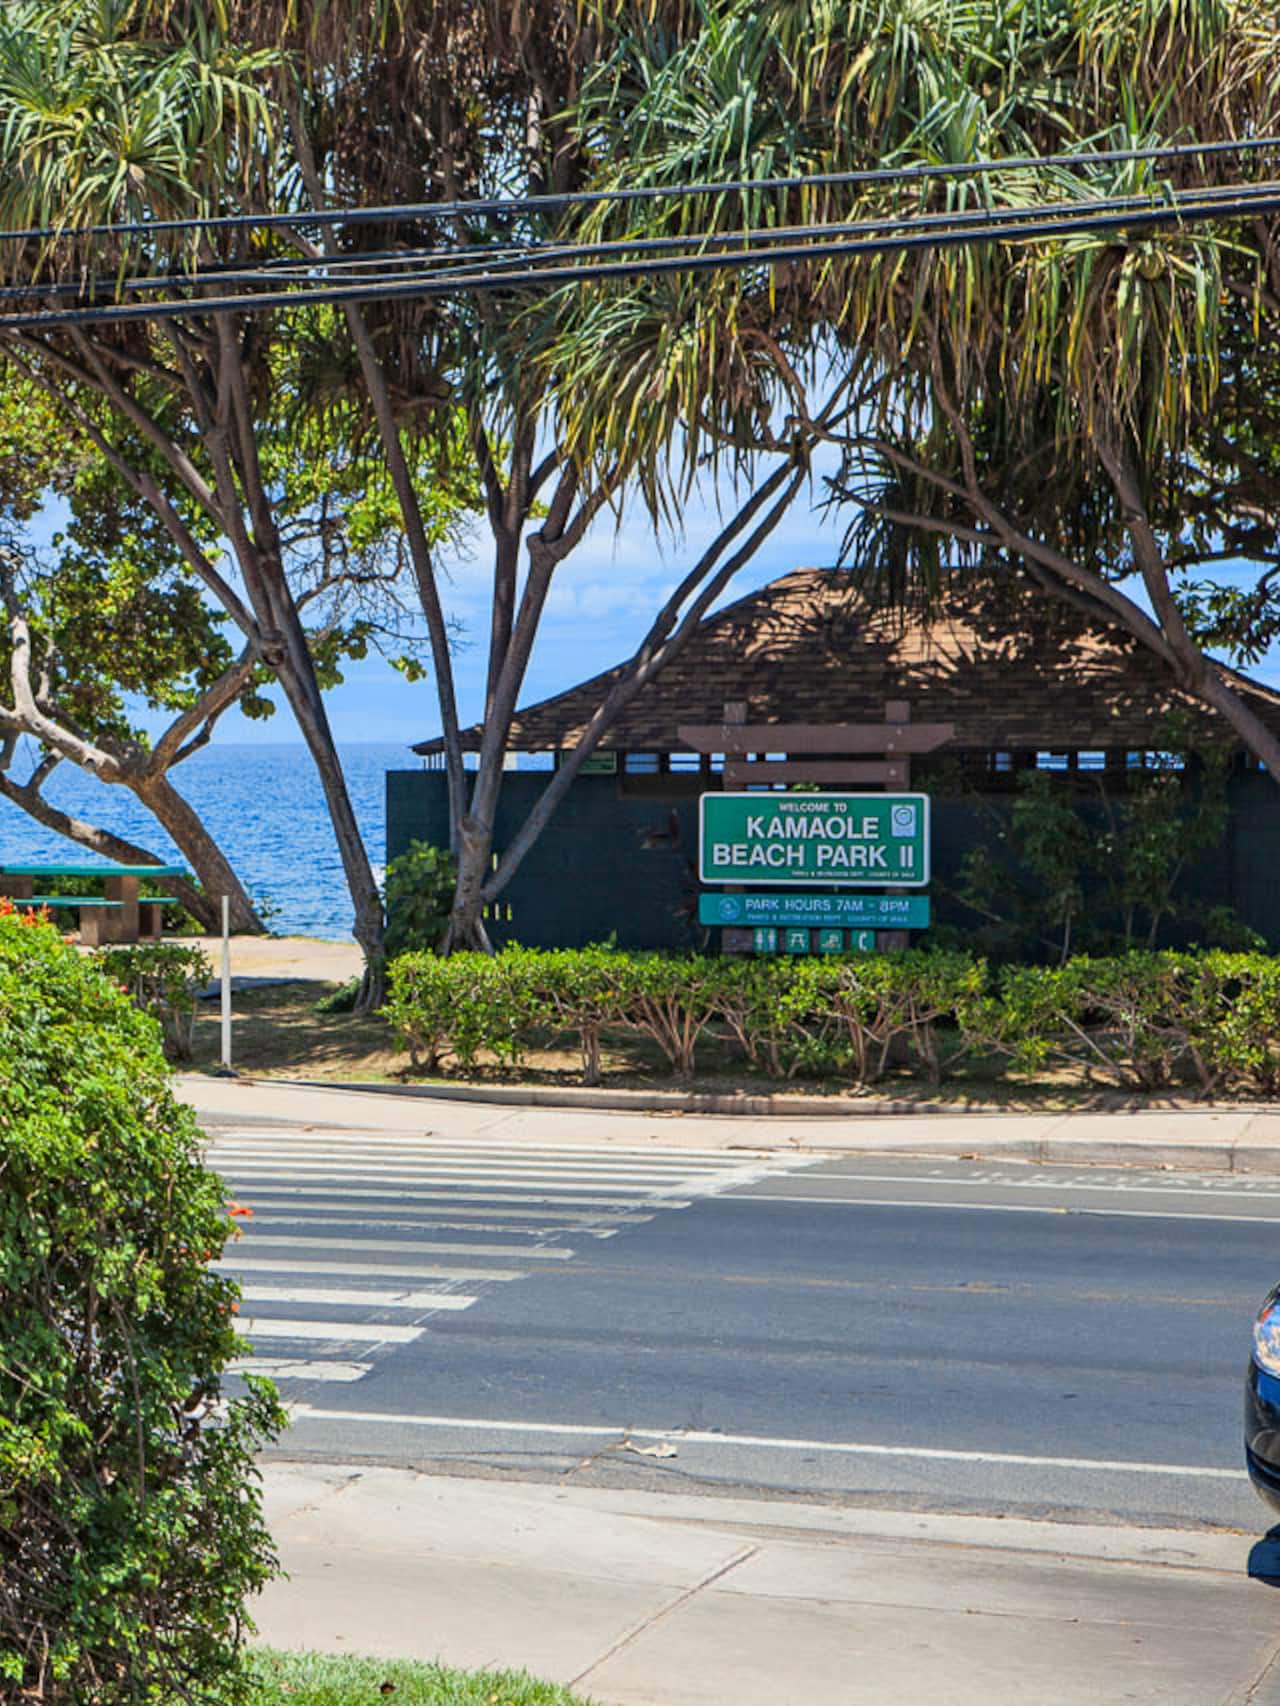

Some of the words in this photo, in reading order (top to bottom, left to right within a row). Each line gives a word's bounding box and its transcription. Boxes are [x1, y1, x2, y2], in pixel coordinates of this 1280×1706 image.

[779, 802, 830, 813] WELCOME
[833, 802, 848, 813] TO
[746, 816, 880, 840] KAMAOLE
[712, 843, 805, 867] BEACH
[816, 845, 887, 868] PARK
[899, 845, 914, 868] II
[744, 898, 780, 911] PARK
[785, 898, 832, 912] HOURS
[836, 899, 864, 912] 7AM
